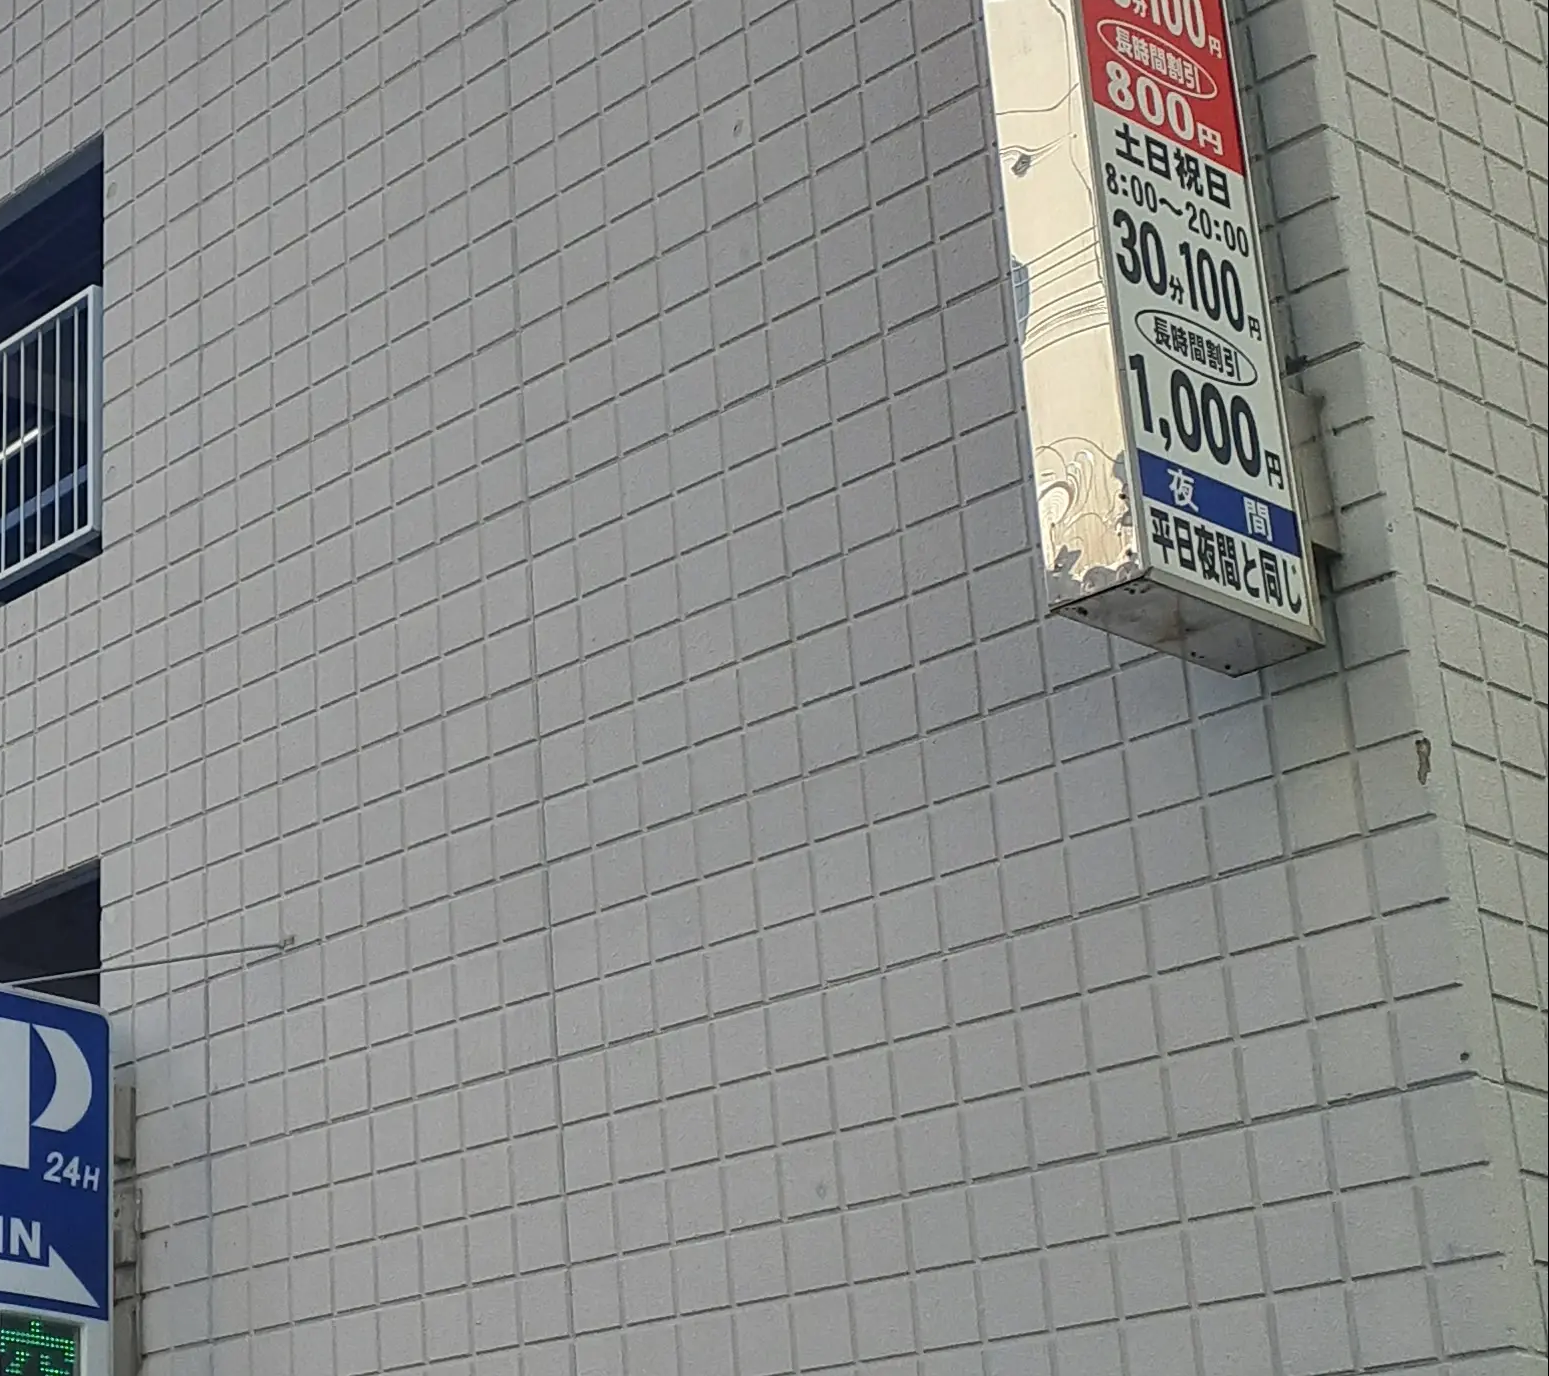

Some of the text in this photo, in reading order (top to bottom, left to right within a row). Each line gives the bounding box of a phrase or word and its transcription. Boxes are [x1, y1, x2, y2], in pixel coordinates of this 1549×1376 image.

[1116, 26, 1201, 93] 長時間割引
[1106, 61, 1222, 155] 800円
[1115, 124, 1231, 209] 土日祝日
[1152, 315, 1241, 381] 長時間割引
[1129, 354, 1284, 490] 1,000円
[1167, 468, 1272, 542] 夜間
[1150, 507, 1301, 614] 平日夜間と同じ
[43, 1152, 100, 1192] 24H
